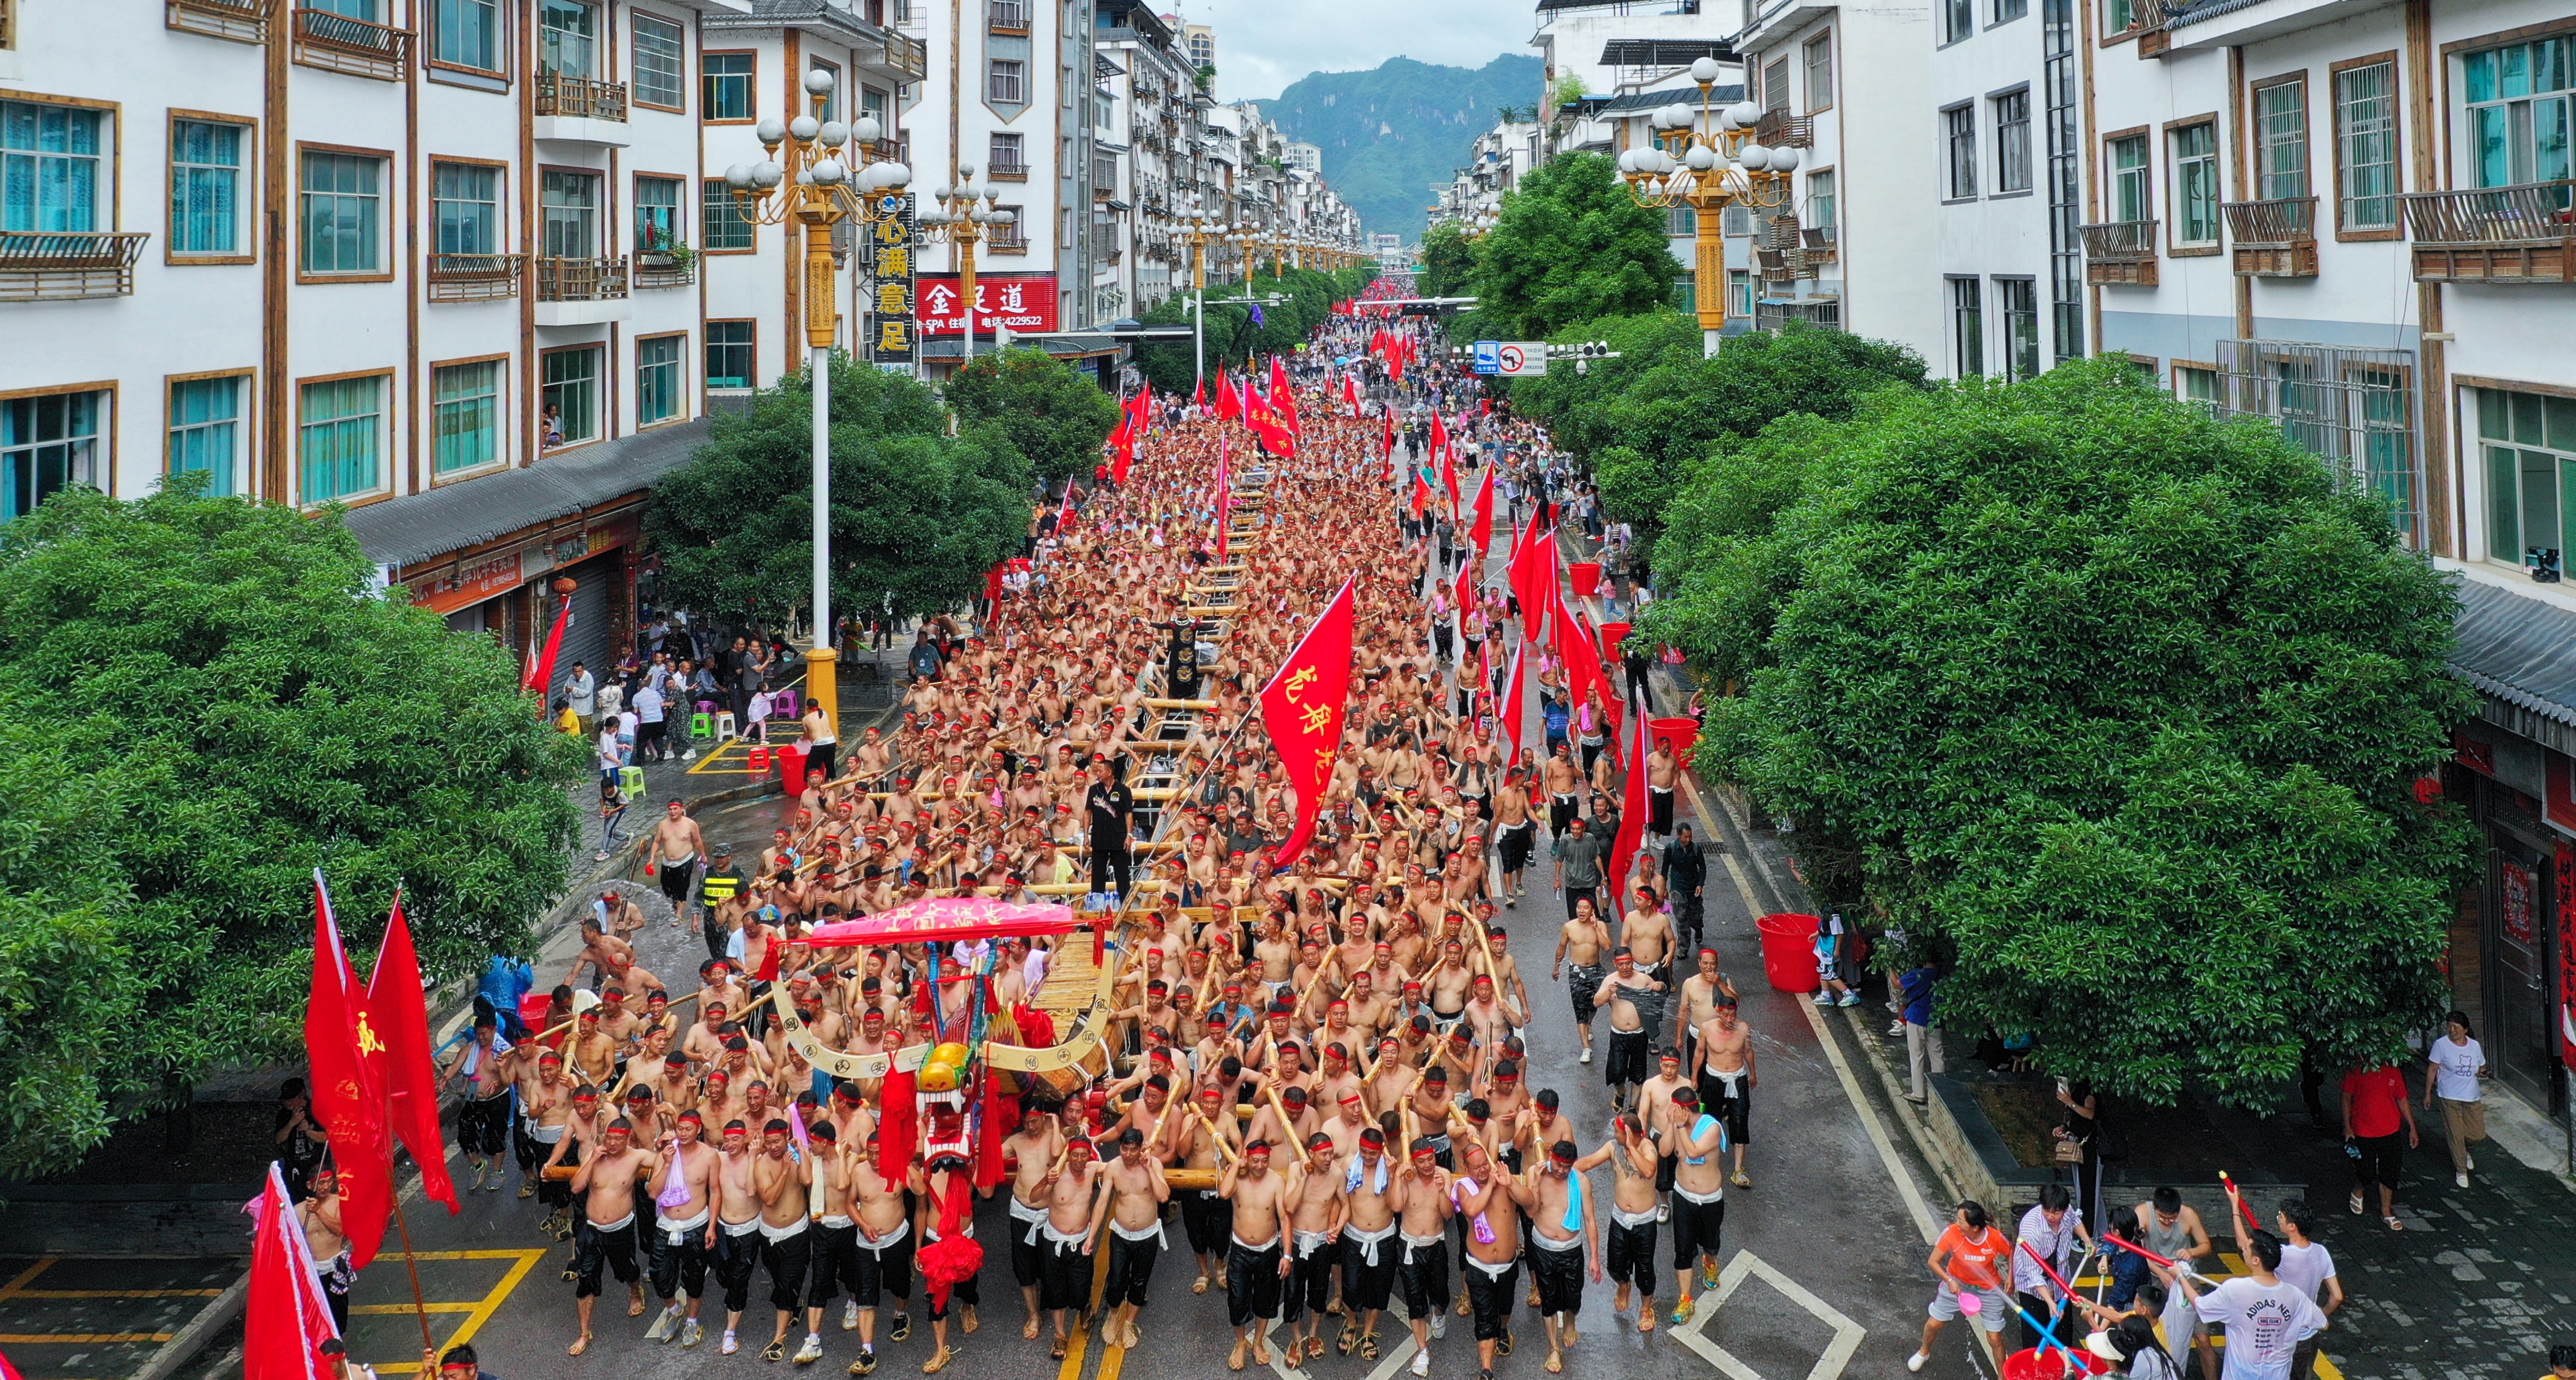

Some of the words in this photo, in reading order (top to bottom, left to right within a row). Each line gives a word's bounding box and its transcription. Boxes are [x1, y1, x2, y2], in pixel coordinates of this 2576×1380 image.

[875, 217, 909, 352] 心满意足
[926, 319, 945, 329] SPA
[2246, 1299, 2276, 1321] ADIDAS
[2277, 1303, 2292, 1321] NEO
